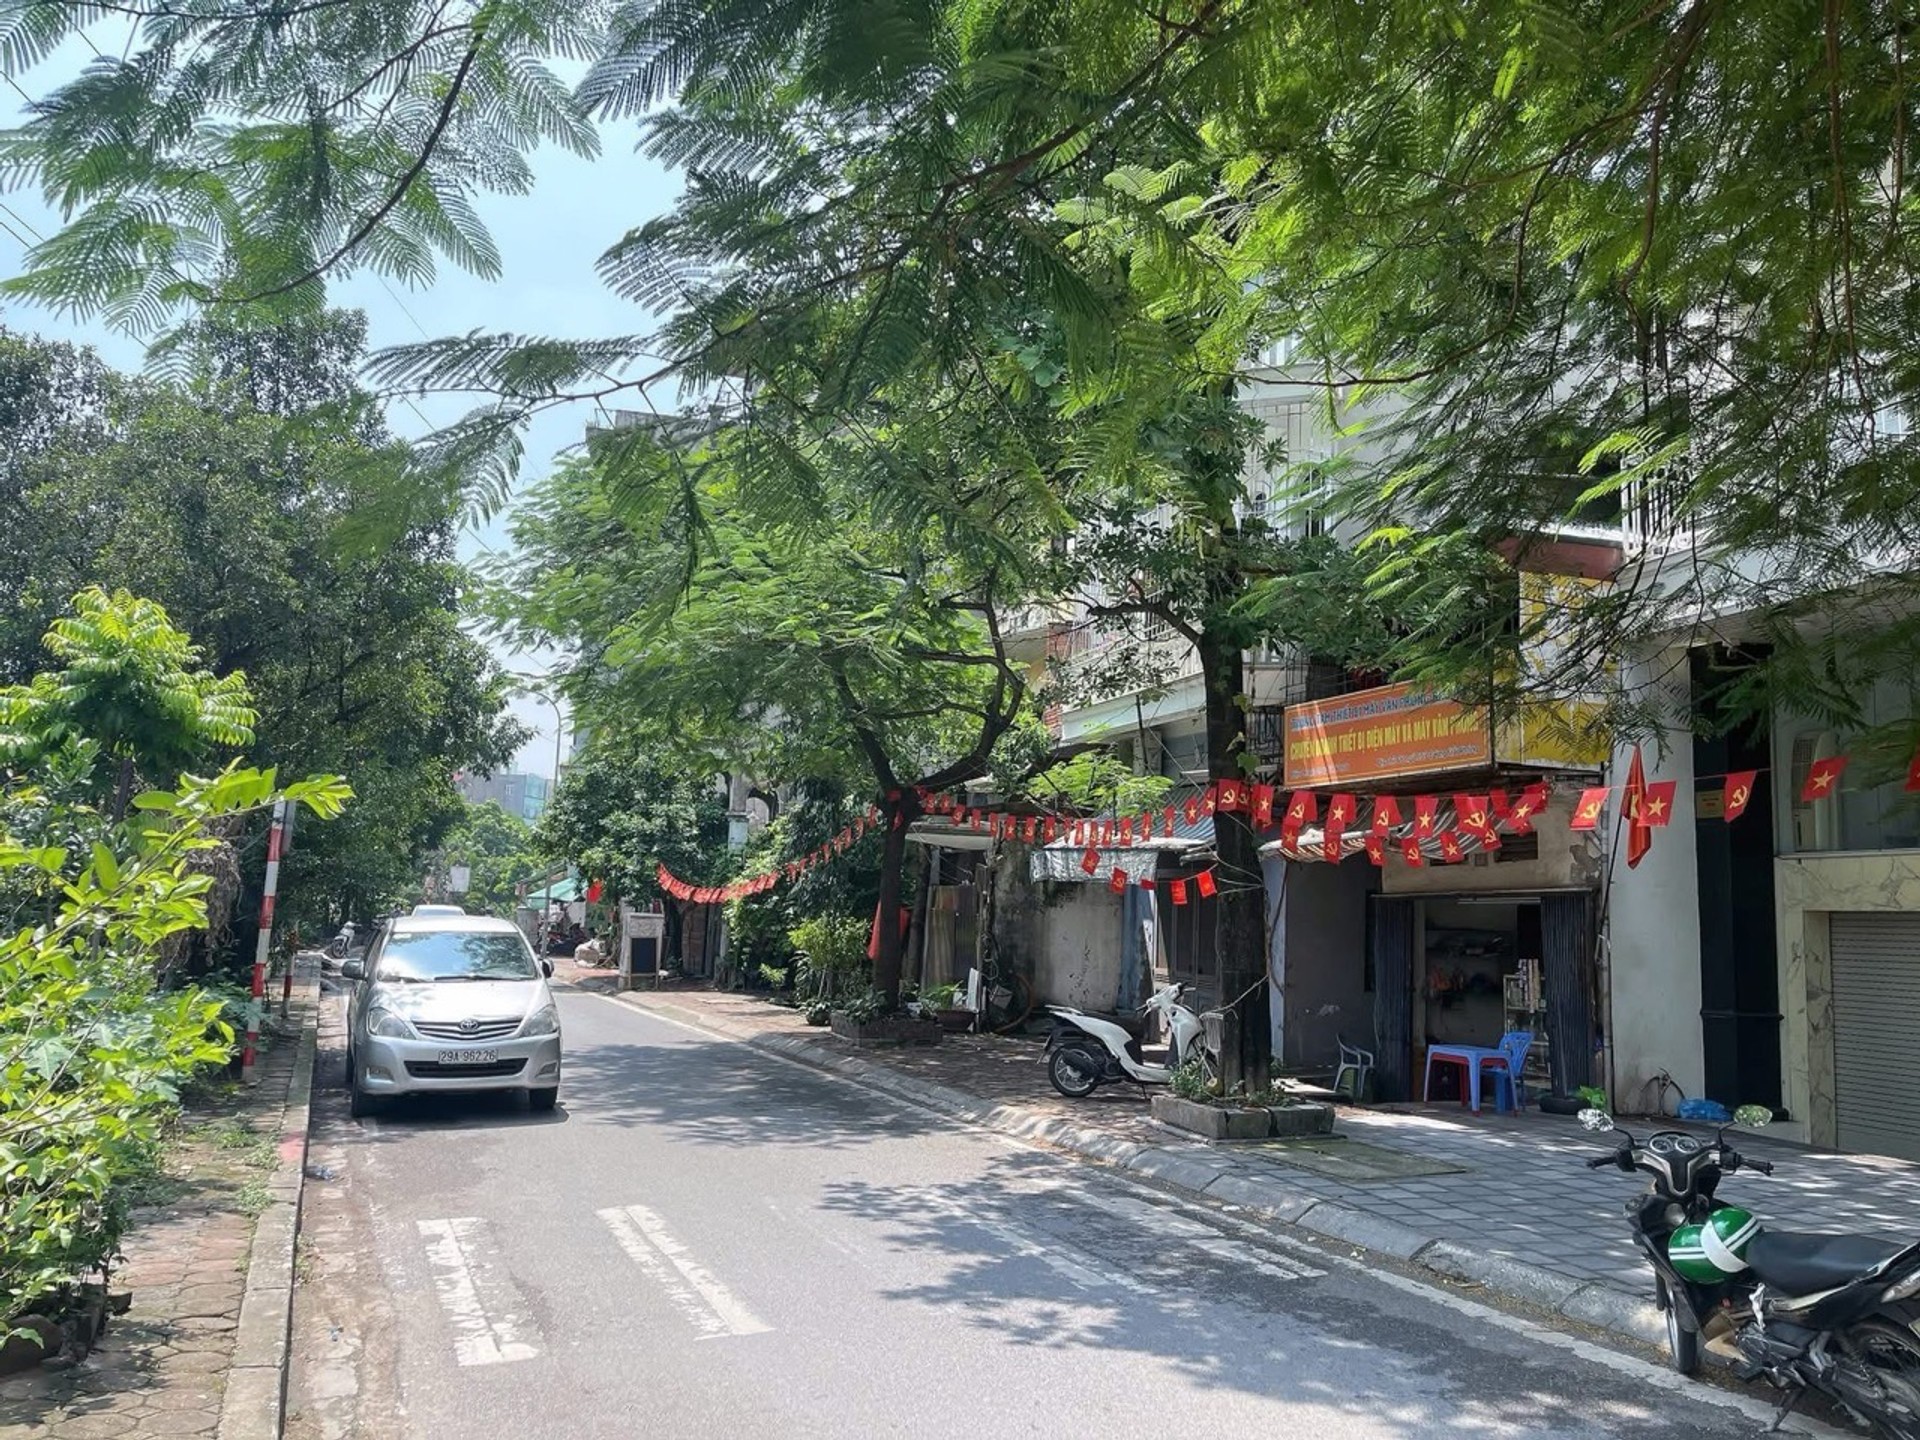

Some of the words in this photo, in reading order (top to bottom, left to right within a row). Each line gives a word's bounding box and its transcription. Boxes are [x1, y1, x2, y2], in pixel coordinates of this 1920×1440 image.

[1339, 728, 1357, 753] THIẾT
[1384, 721, 1400, 747] MÁY
[1402, 719, 1413, 744] VÀ
[1413, 716, 1430, 742] MÁY
[1432, 713, 1449, 738] VĂN
